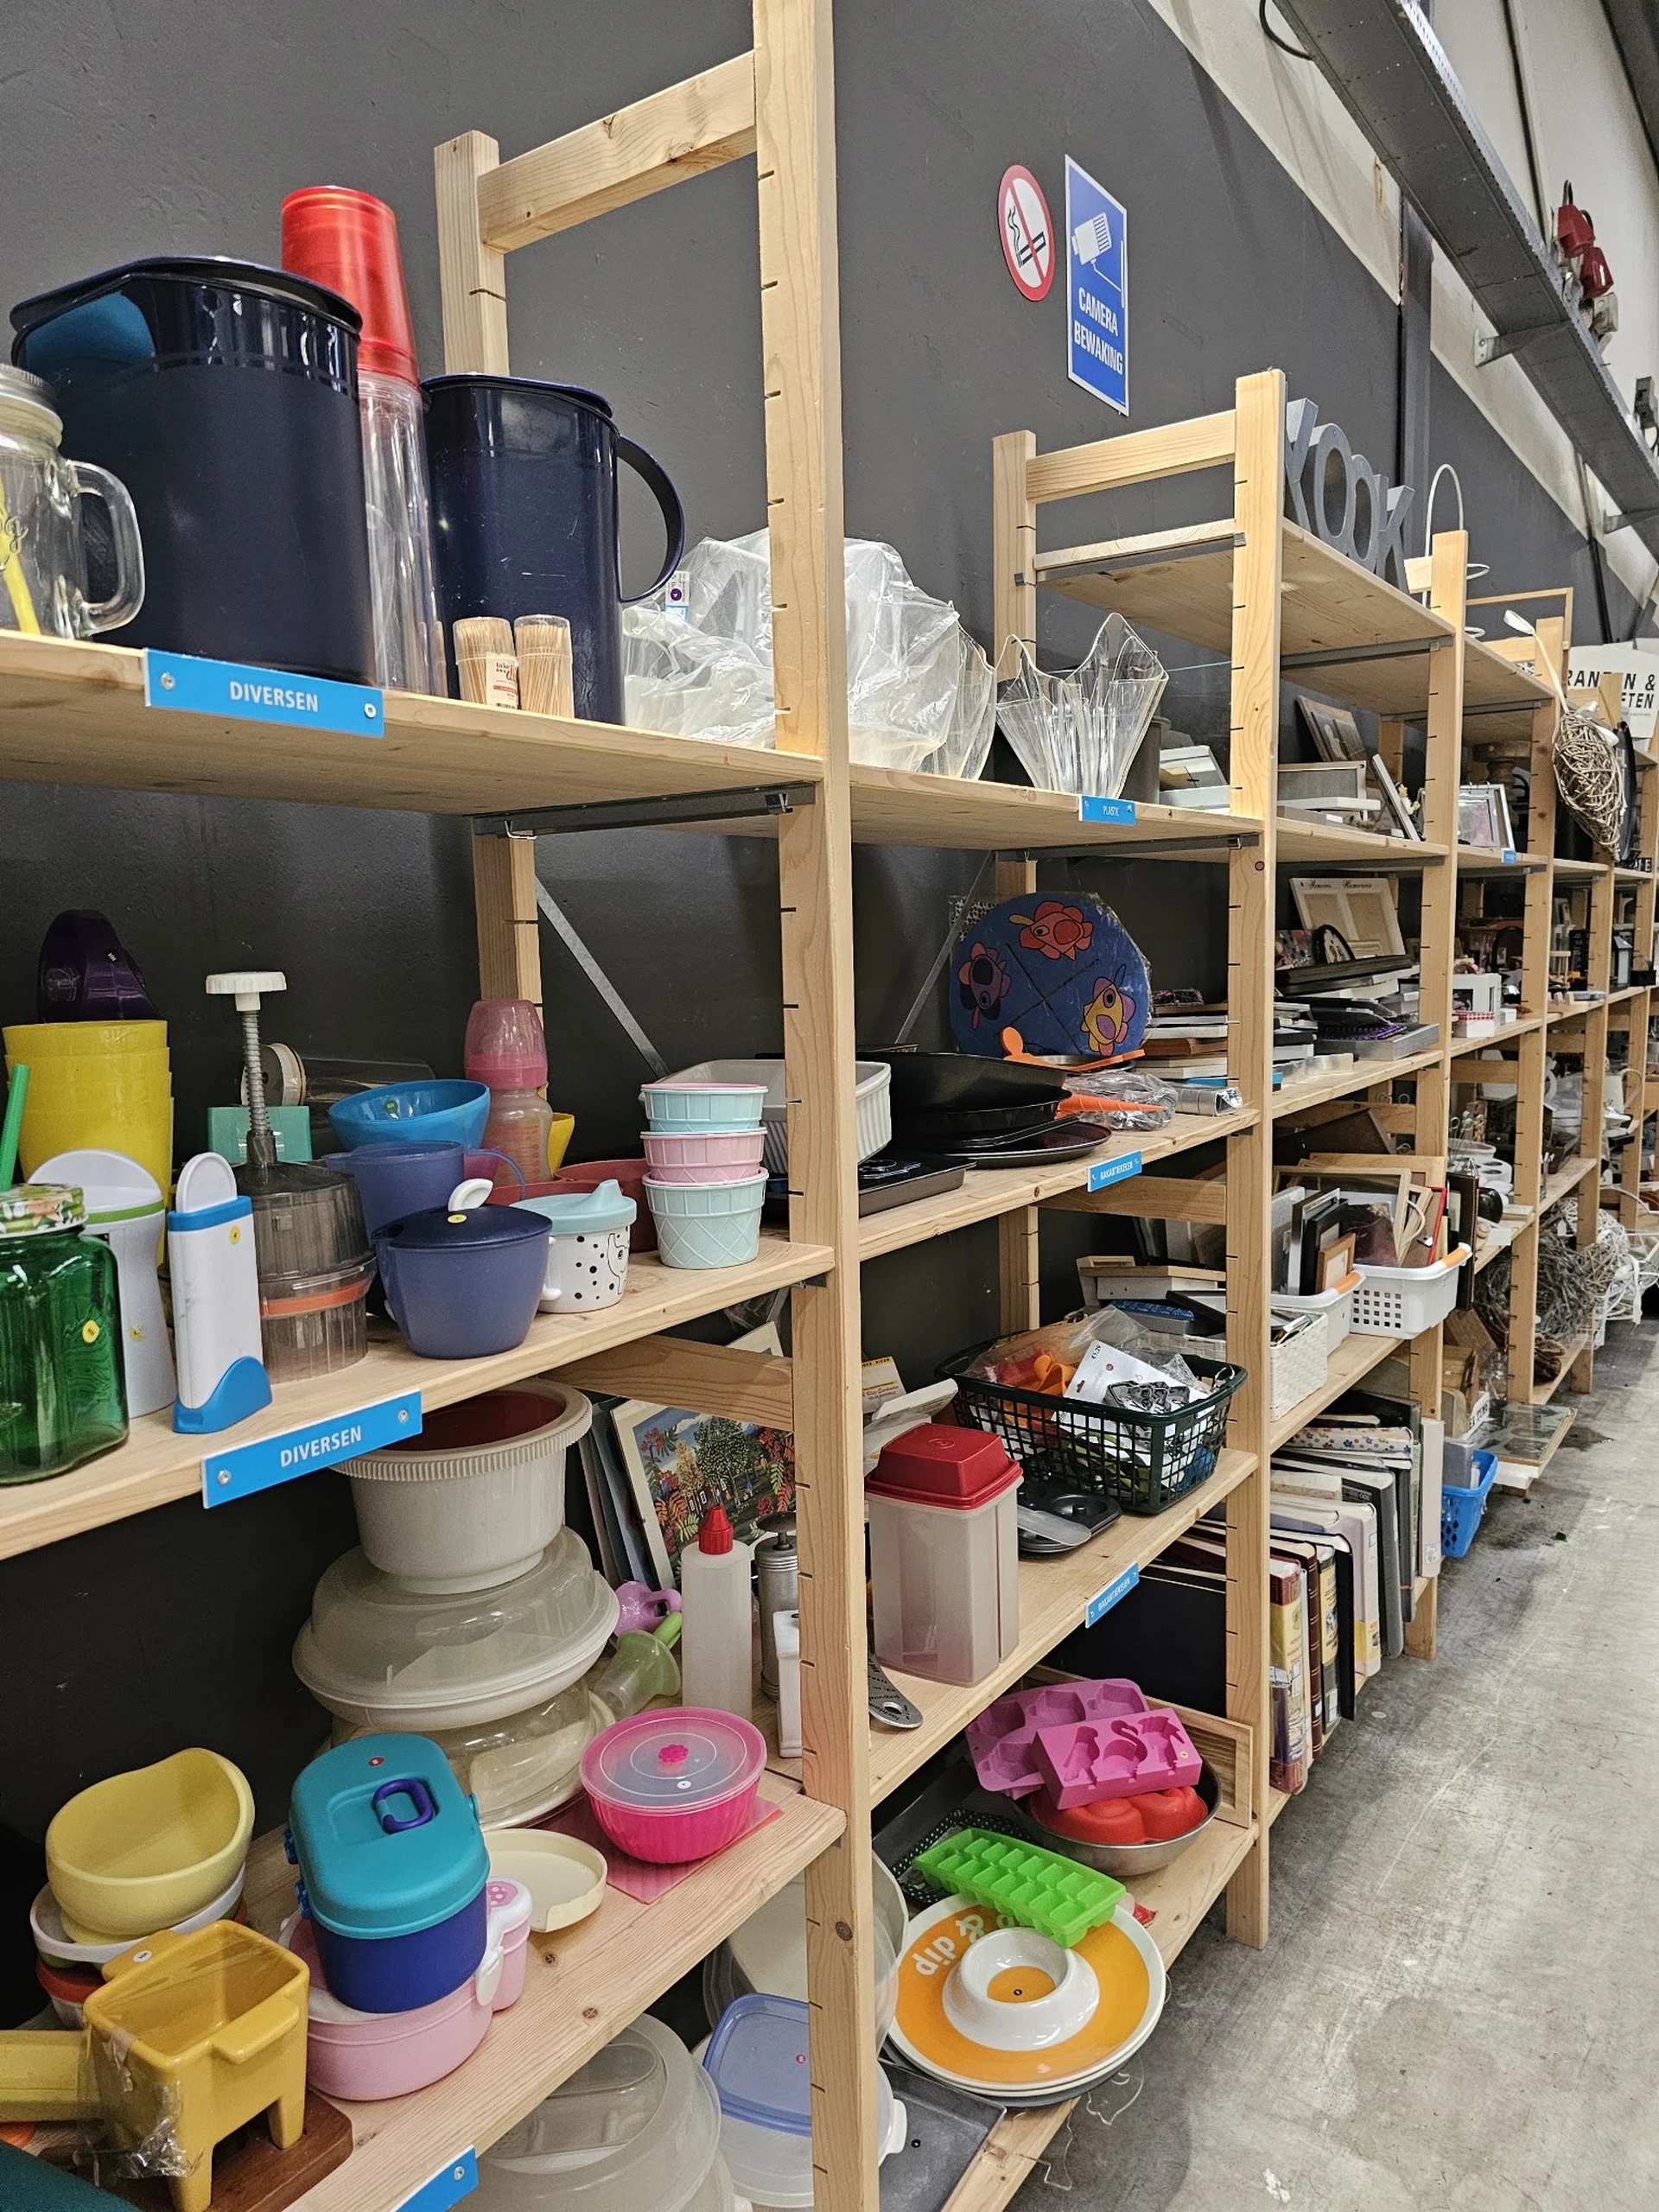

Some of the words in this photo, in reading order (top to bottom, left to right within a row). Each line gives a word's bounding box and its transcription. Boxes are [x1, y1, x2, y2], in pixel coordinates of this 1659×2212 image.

[1078, 287, 1119, 337] CAMERA
[1074, 320, 1123, 375] BEWAKING
[230, 681, 320, 713] DIVERSEN
[1644, 674, 1656, 691] &
[1103, 804, 1120, 817] PLASTIC
[281, 1425, 362, 1468] DIVERSEN
[911, 1936, 956, 1976] dip
